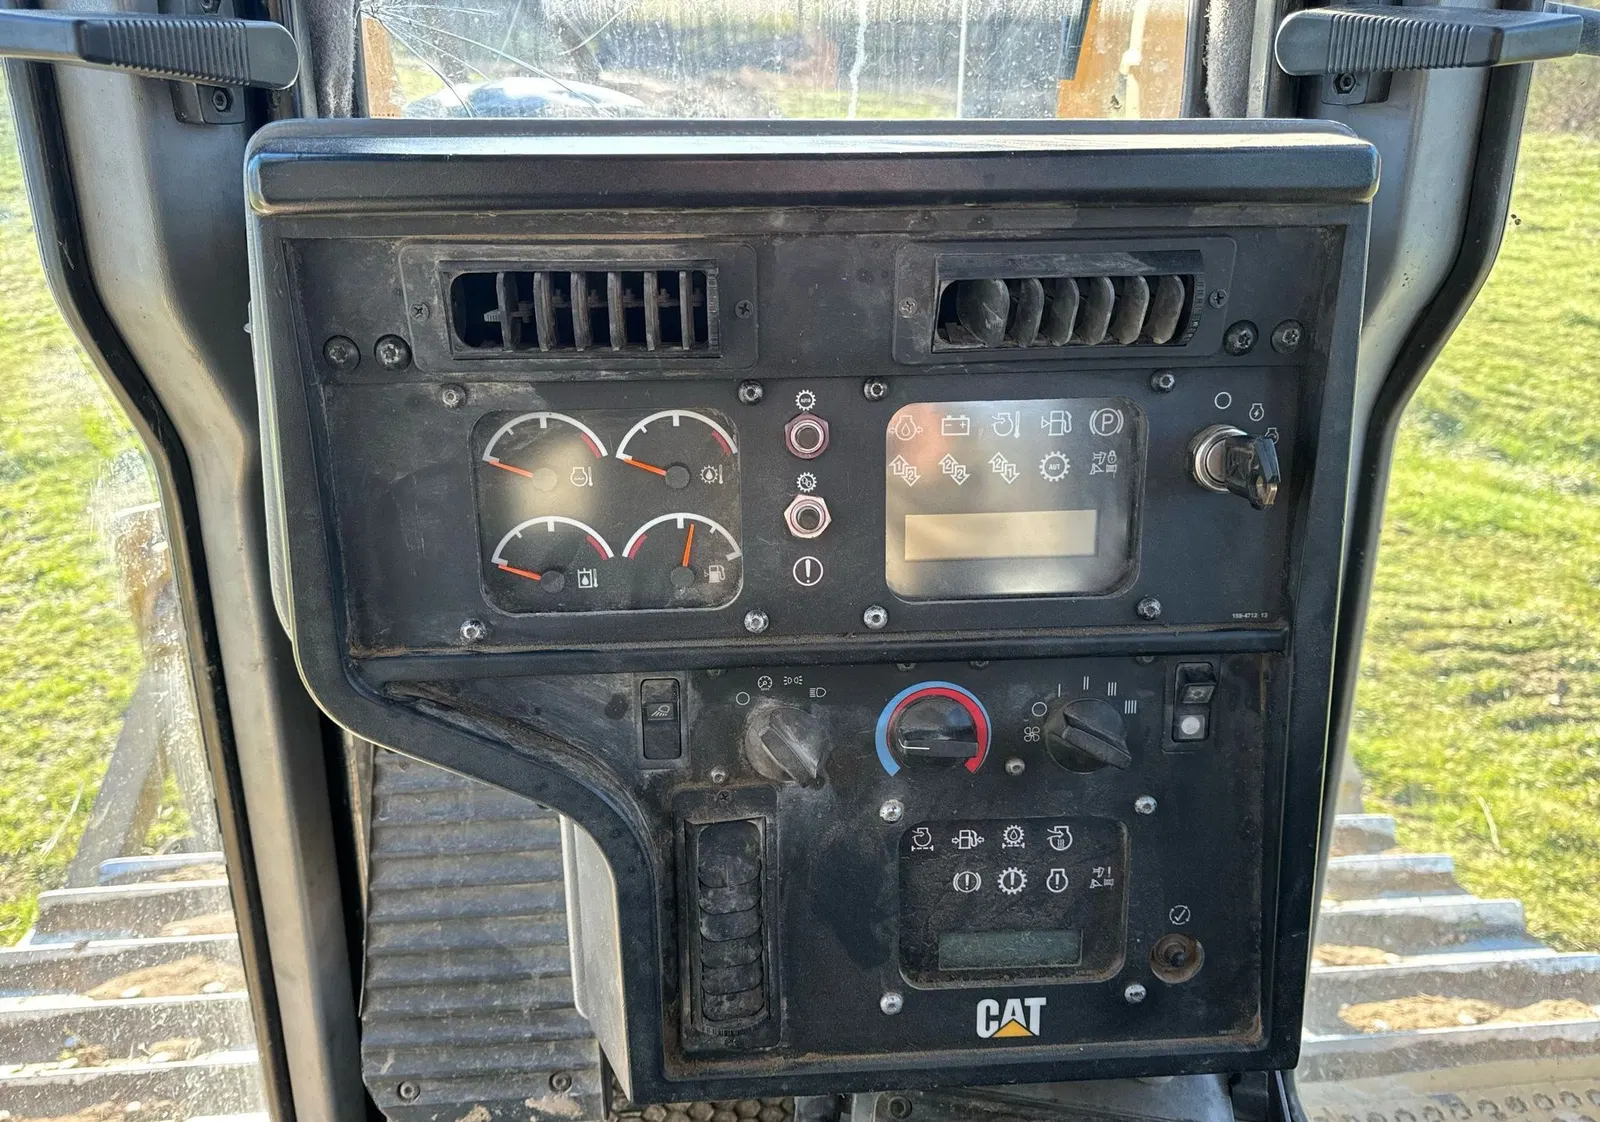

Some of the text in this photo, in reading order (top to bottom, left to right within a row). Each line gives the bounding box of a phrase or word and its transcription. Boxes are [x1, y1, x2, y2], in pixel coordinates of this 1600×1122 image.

[1101, 413, 1114, 432] P
[896, 461, 914, 481] 1 2
[945, 460, 963, 479] 2 2
[995, 458, 1012, 478] 2 1
[976, 997, 1047, 1039] CAT
